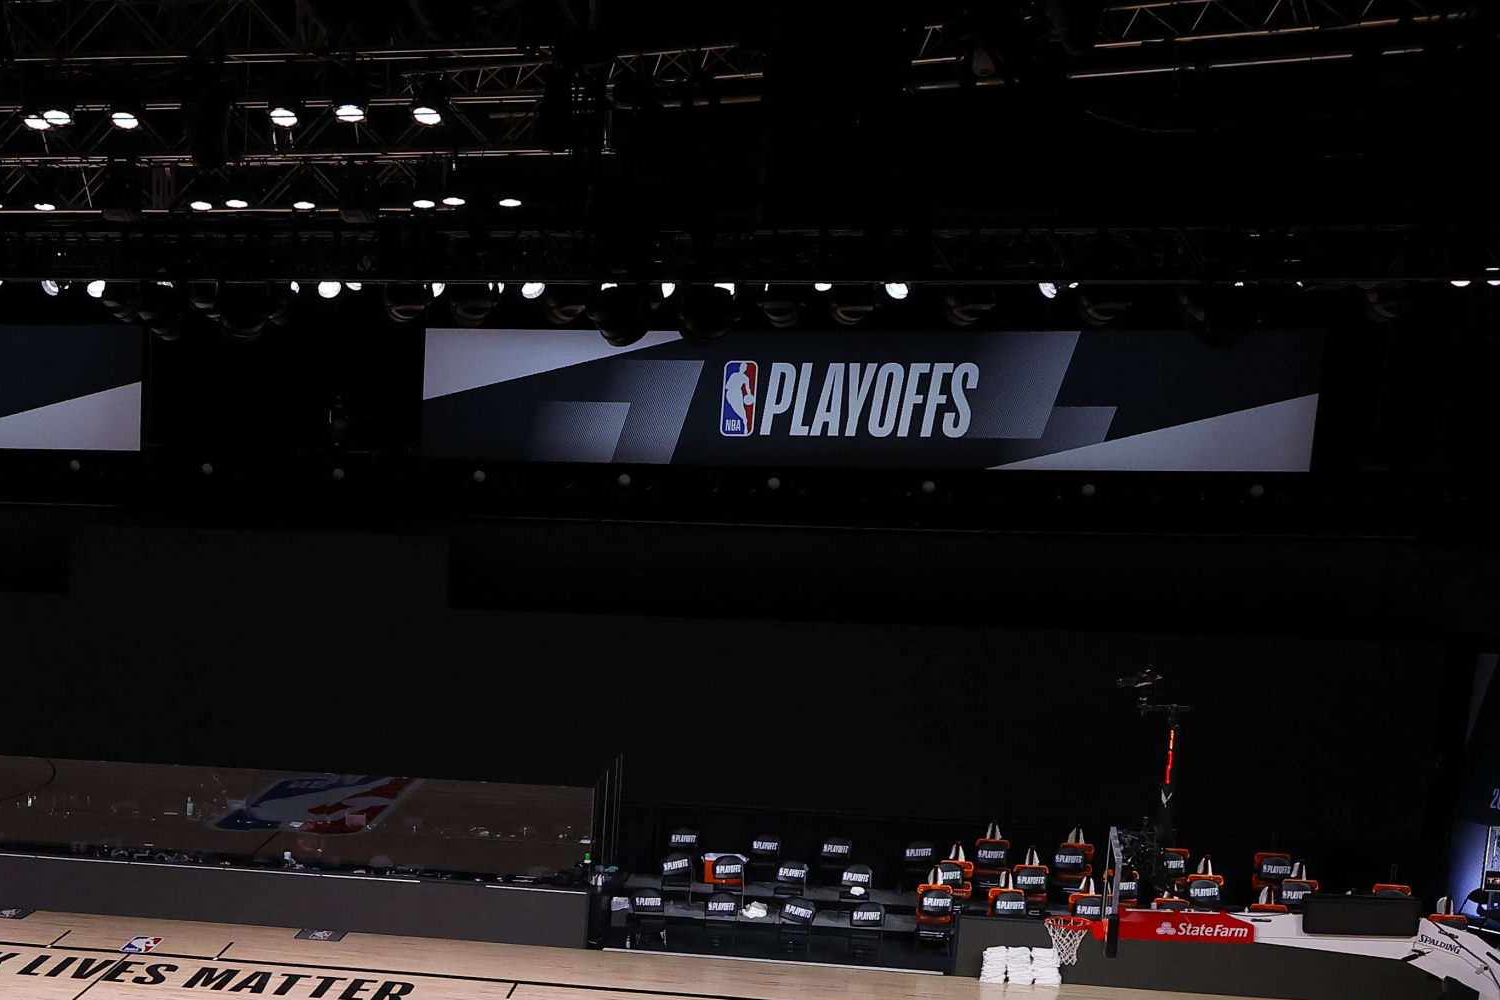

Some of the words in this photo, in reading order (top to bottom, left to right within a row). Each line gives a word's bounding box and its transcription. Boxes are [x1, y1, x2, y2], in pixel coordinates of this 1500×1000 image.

[759, 362, 980, 438] PLAYOFFS
[725, 419, 741, 432] NBA
[1418, 934, 1462, 955] SPALDING
[17, 954, 179, 985] LIVES
